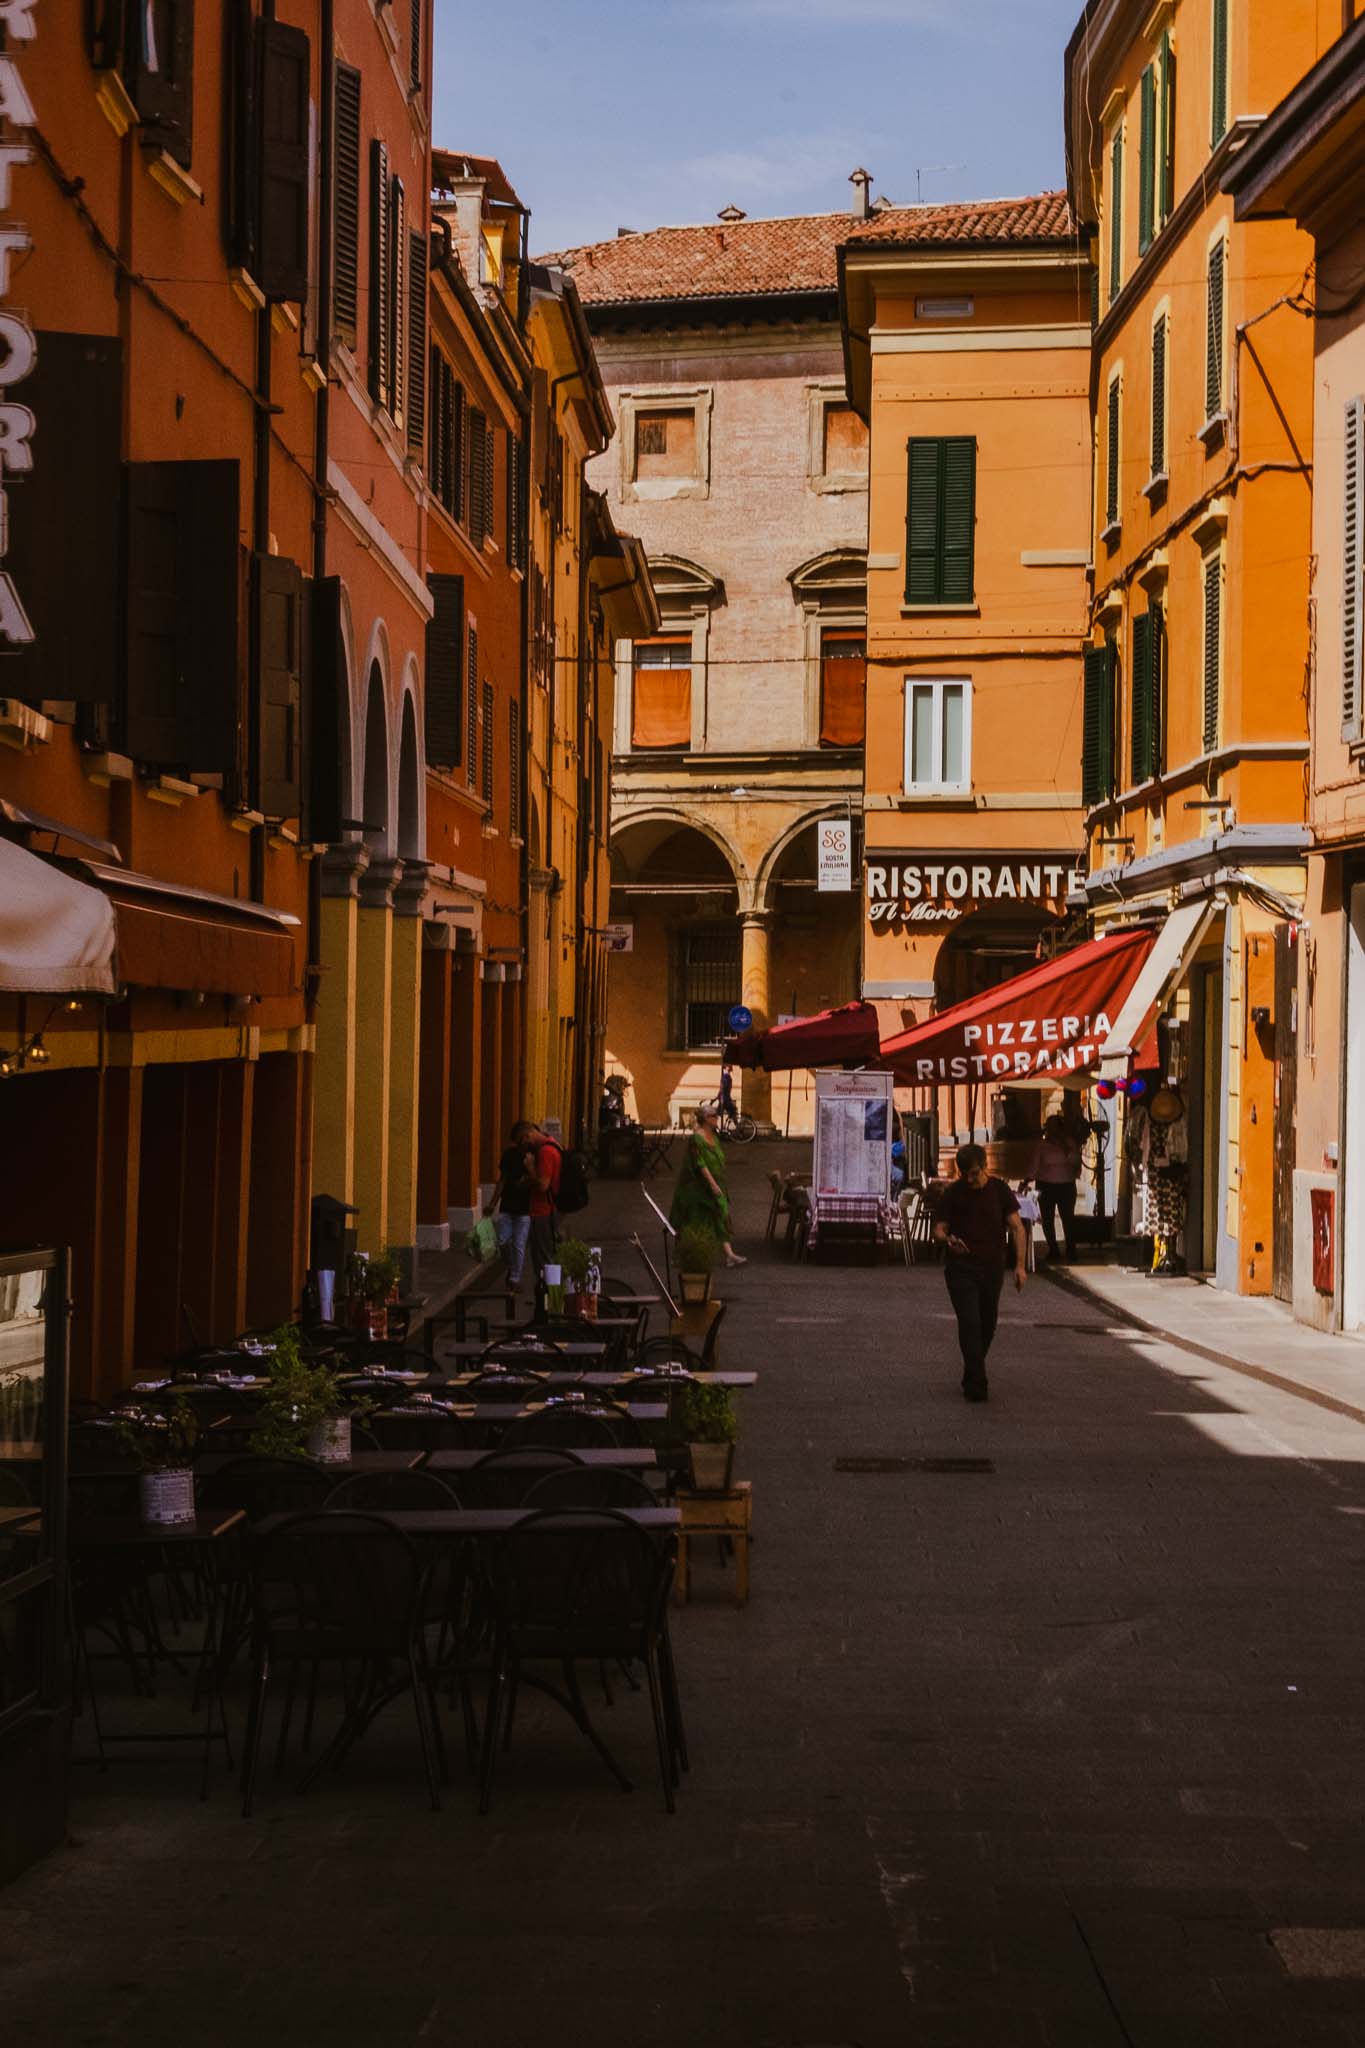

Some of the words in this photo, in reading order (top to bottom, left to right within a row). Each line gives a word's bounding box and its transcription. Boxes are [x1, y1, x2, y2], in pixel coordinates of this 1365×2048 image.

[867, 866, 1085, 898] RISTORANTE
[901, 903, 962, 921] Moro
[964, 1013, 1111, 1047] PIZZERIA
[916, 1044, 1105, 1080] RISTORANT
